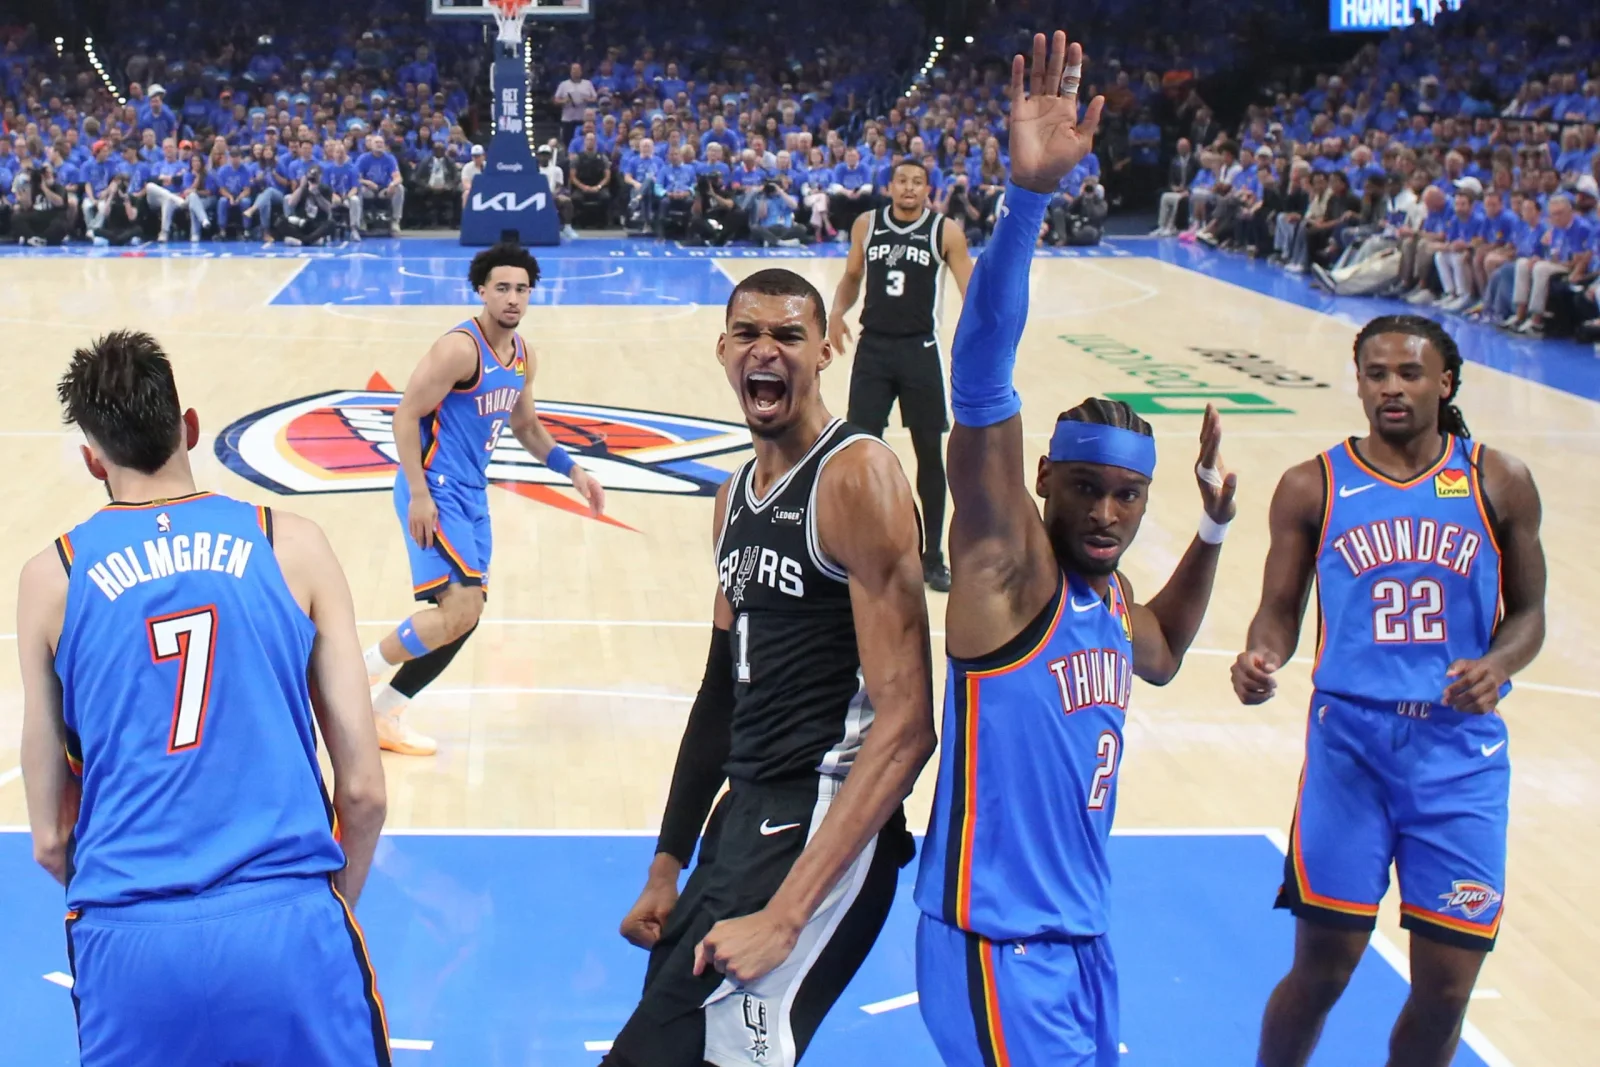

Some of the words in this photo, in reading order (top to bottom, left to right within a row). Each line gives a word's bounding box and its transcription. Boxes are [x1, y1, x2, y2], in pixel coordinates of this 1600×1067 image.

[502, 88, 518, 101] GET
[502, 102, 518, 116] THE
[496, 162, 523, 172] Google
[472, 192, 546, 211] KIA
[868, 244, 930, 267] SPURS
[886, 270, 905, 296] 3
[485, 419, 503, 452] 3
[775, 511, 800, 520] LEDGER
[1333, 517, 1481, 577] THUNDER
[87, 531, 253, 602] HOLMGREN
[719, 546, 805, 603] SPURS
[1372, 577, 1447, 643] 22
[736, 613, 750, 682] 1
[145, 604, 219, 754] 7
[1048, 648, 1132, 715] THUND
[1088, 730, 1120, 811] 2
[1450, 890, 1486, 905] OKC
